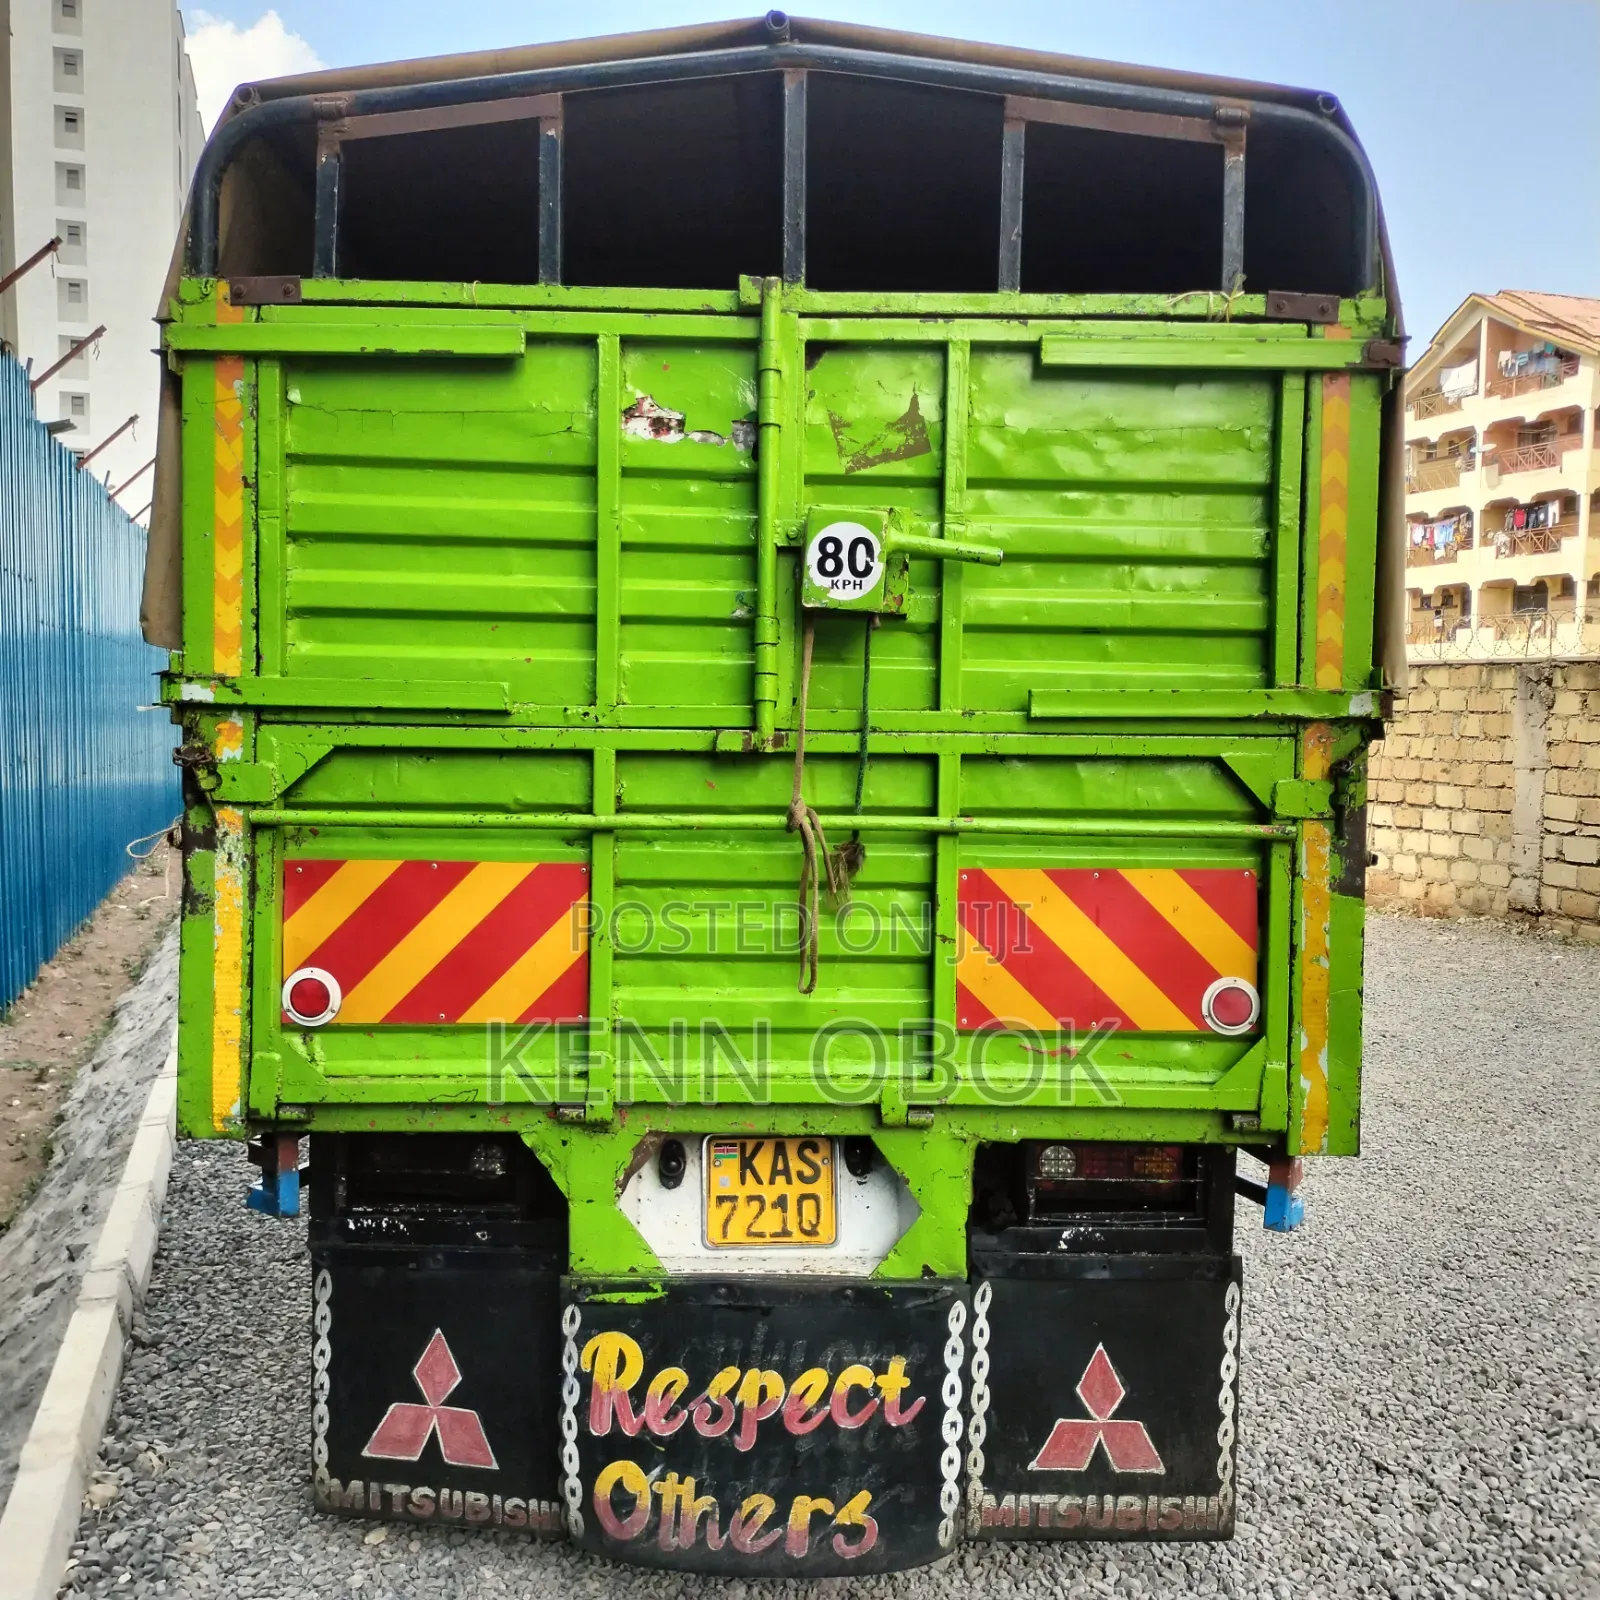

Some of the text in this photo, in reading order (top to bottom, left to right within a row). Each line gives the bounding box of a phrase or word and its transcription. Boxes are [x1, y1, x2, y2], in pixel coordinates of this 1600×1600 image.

[816, 536, 875, 579] 80
[830, 579, 863, 590] KPH
[739, 1140, 822, 1186] KAS
[716, 1193, 821, 1239] 721Q
[580, 1331, 926, 1451] Respect
[329, 1477, 560, 1531] MITSUBISHI
[594, 1460, 879, 1559] Others
[981, 1494, 1219, 1531] MITSUBISHI
